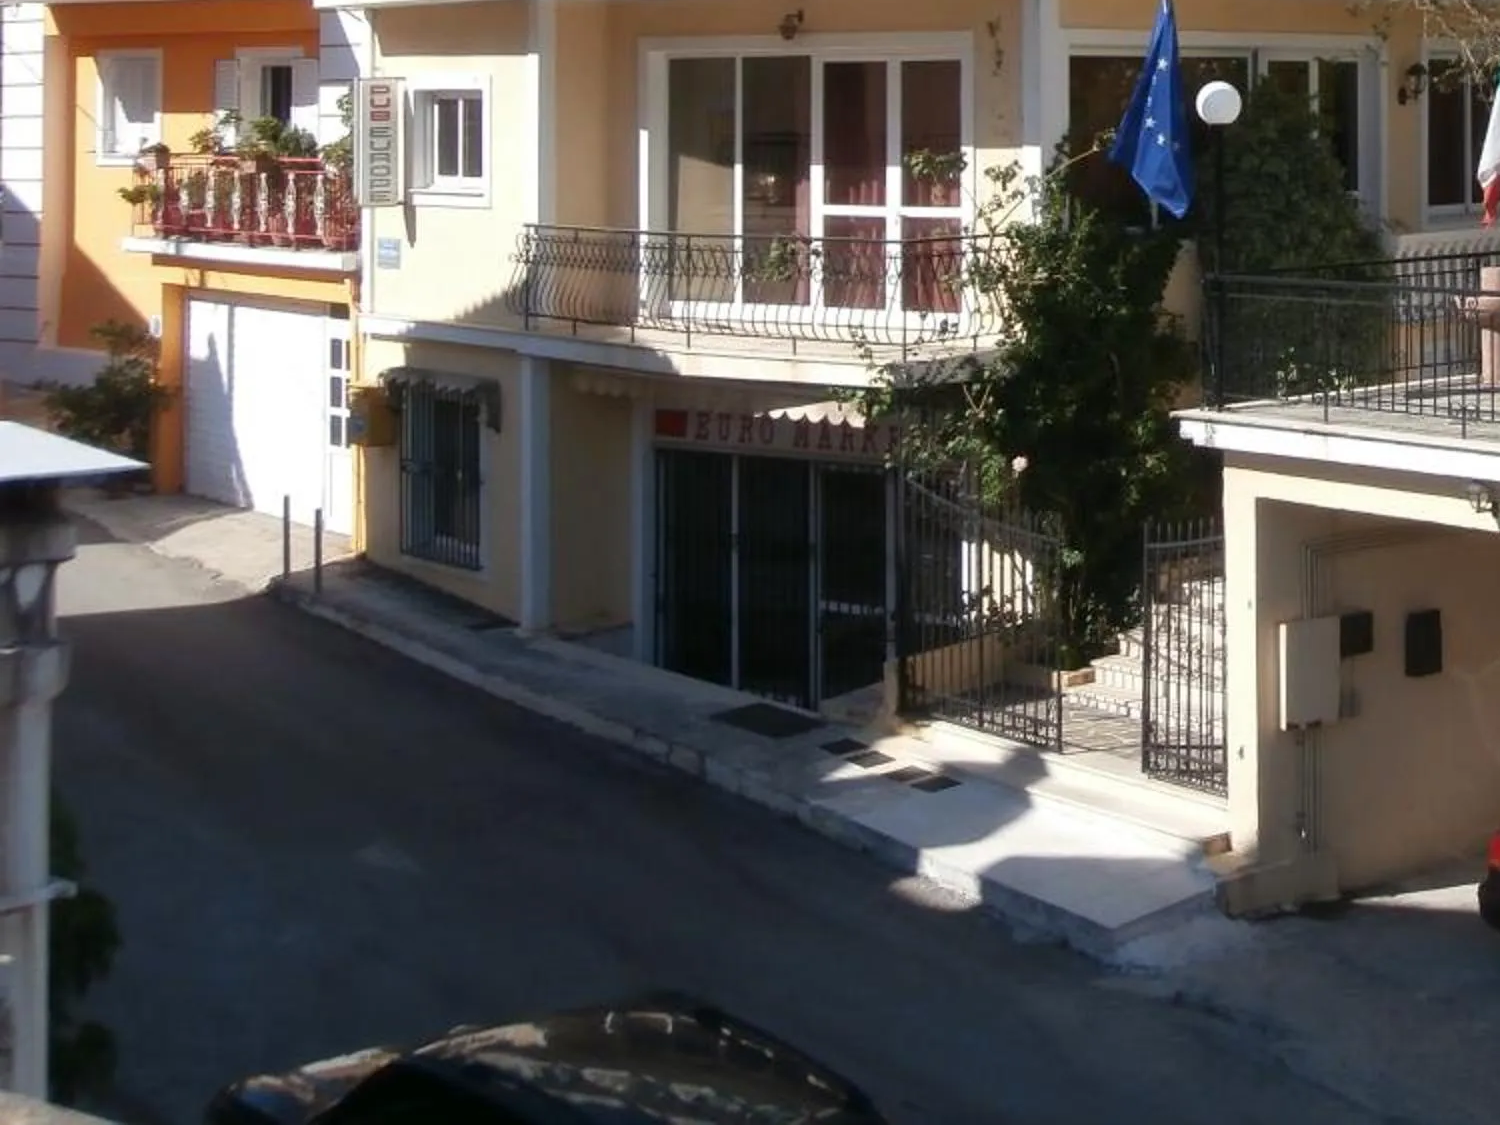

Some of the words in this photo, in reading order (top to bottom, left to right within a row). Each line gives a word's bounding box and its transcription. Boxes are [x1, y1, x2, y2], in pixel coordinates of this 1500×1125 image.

[369, 84, 391, 122] PUB
[369, 125, 392, 203] EUROPE
[694, 410, 775, 445] EURO
